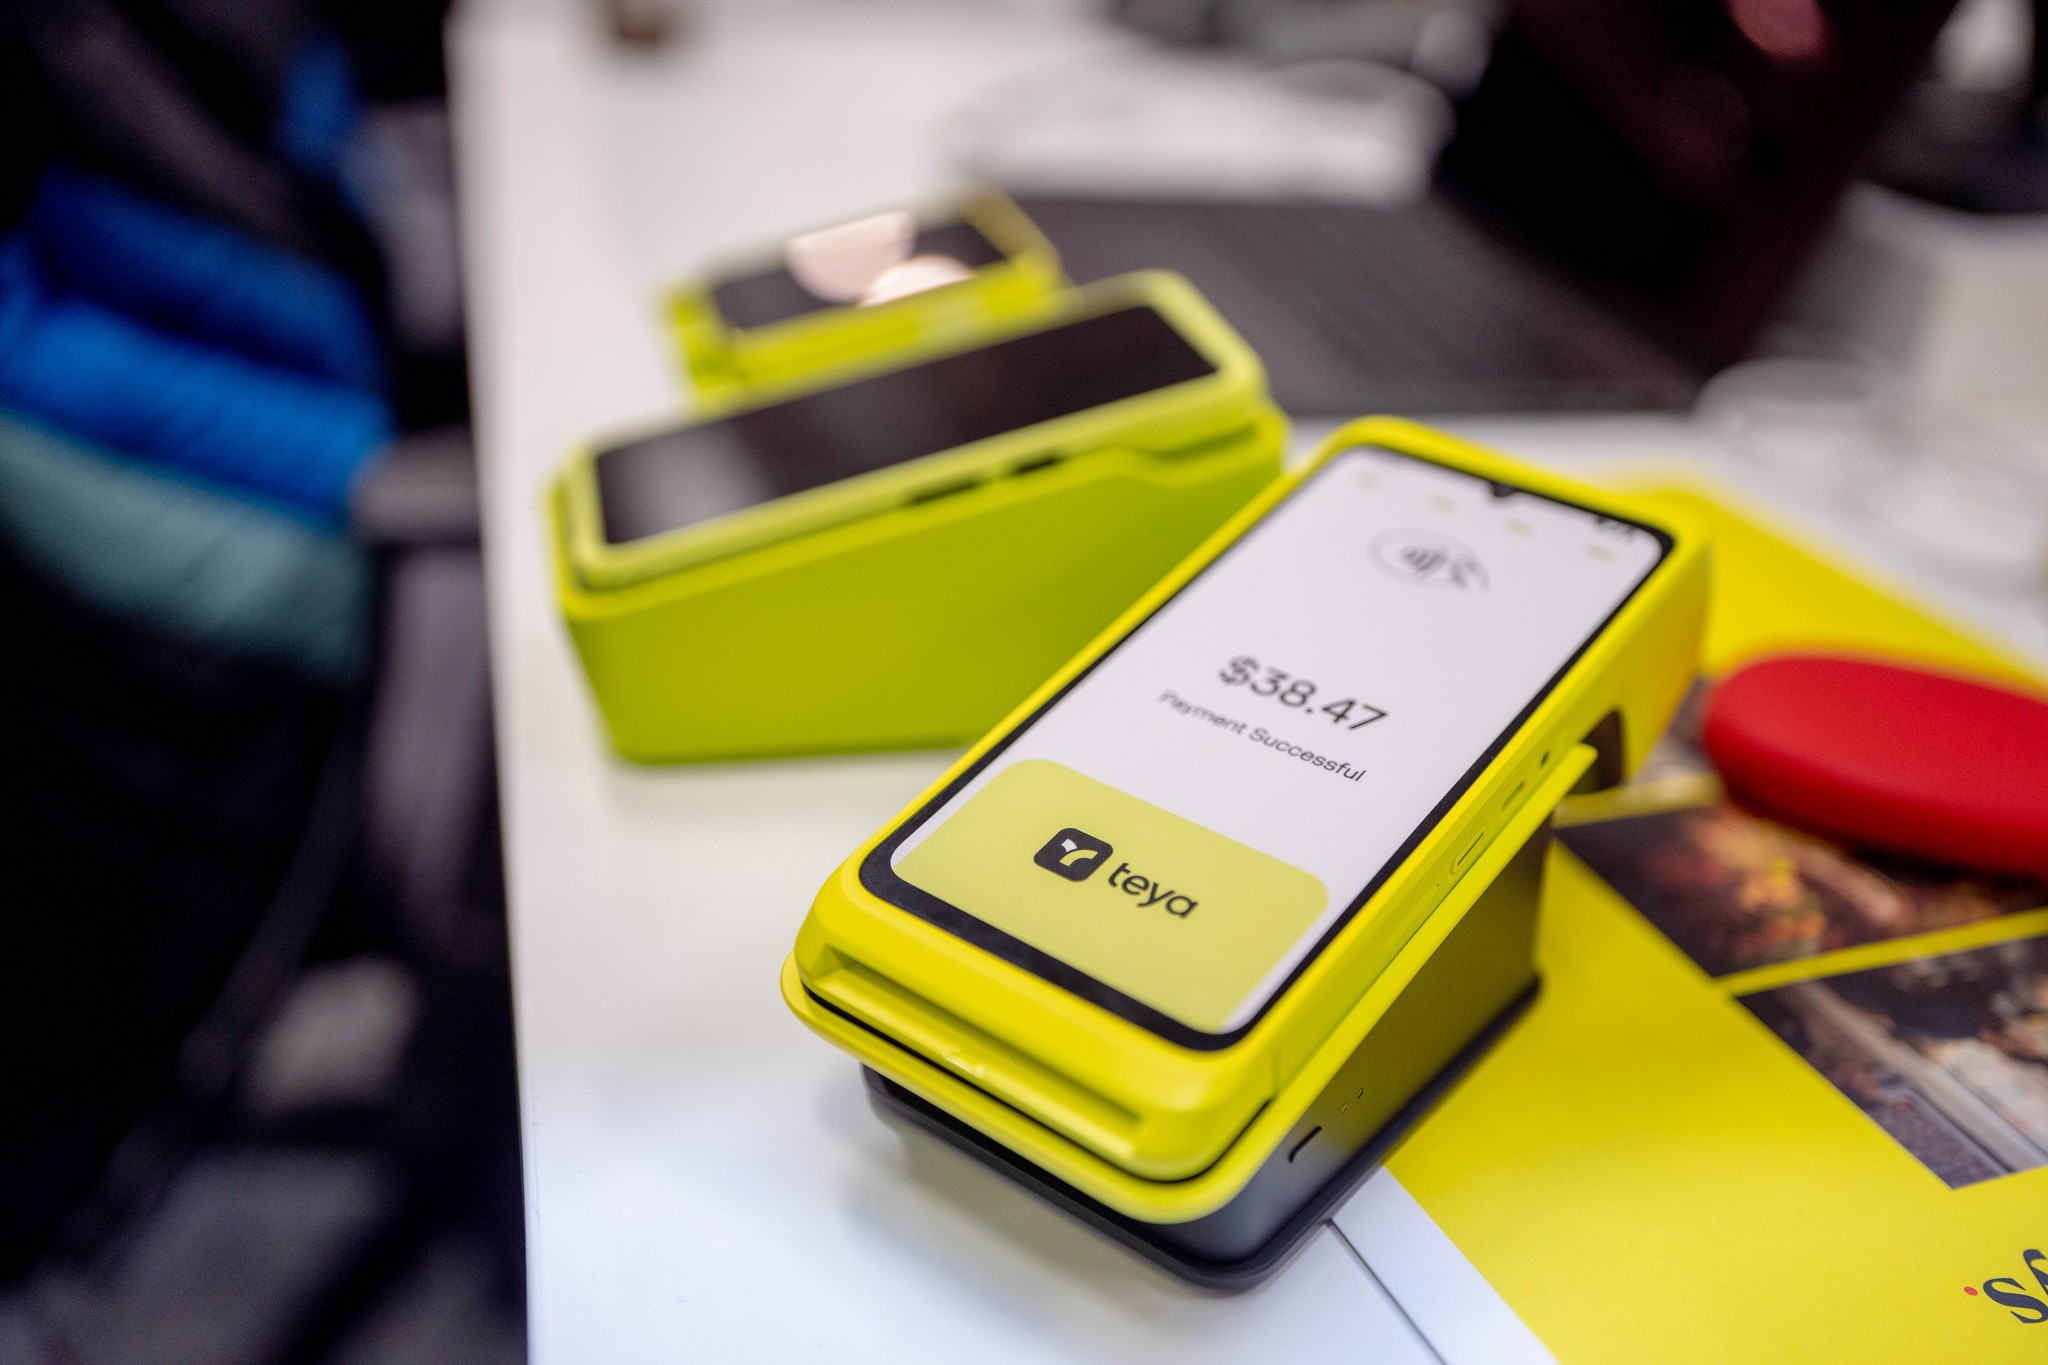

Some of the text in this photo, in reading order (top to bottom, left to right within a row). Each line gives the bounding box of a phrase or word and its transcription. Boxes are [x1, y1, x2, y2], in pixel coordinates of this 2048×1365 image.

[1219, 655, 1388, 730] $38.47
[1158, 689, 1367, 782] Payment Successful
[1108, 862, 1198, 919] teya
